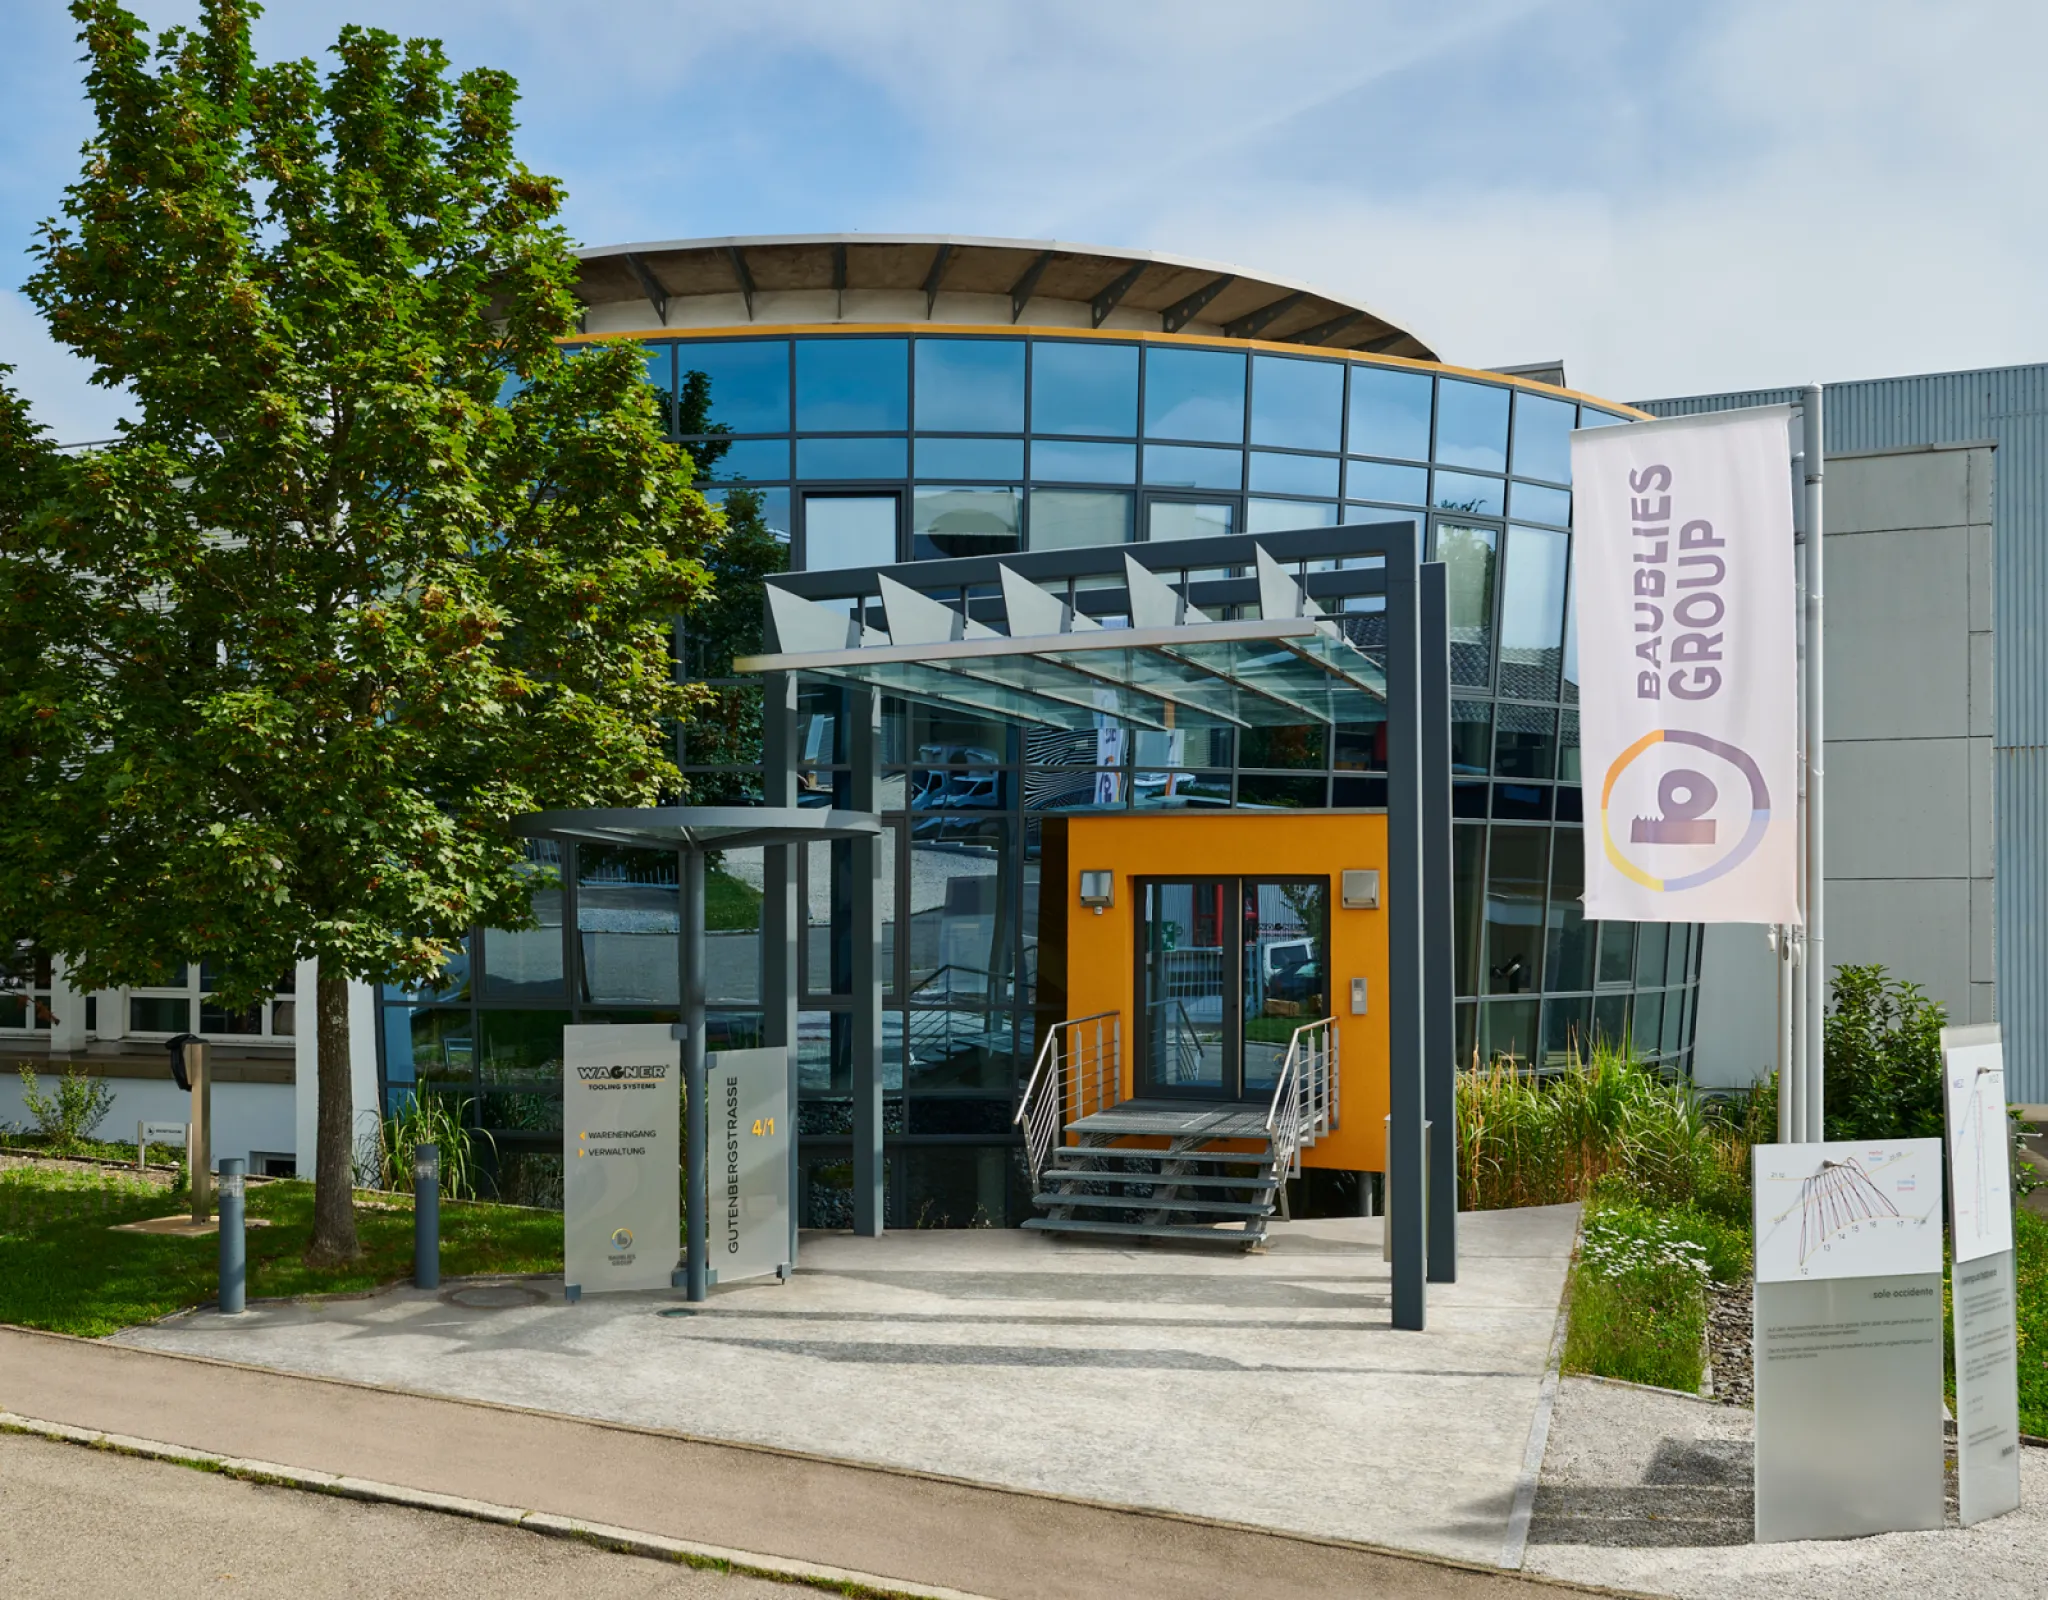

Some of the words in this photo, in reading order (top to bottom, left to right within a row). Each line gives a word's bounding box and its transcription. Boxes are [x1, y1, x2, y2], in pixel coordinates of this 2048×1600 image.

[1628, 464, 1673, 701] BAUBLIES
[1667, 519, 1727, 701] GROUP
[576, 1065, 666, 1080] WAGNER
[588, 1083, 622, 1091] TOOLING
[622, 1082, 657, 1090] SYSTEMS
[751, 1116, 775, 1137] 4/1
[588, 1129, 657, 1140] WARENEINGANG
[588, 1146, 646, 1157] VERWALTUNG
[727, 1076, 738, 1254] GUTENBERGSTRASSE
[1823, 1243, 1831, 1252] 13
[1800, 1267, 1809, 1276] 12
[1873, 1288, 1891, 1299] sole
[1892, 1287, 1934, 1297] occidente
